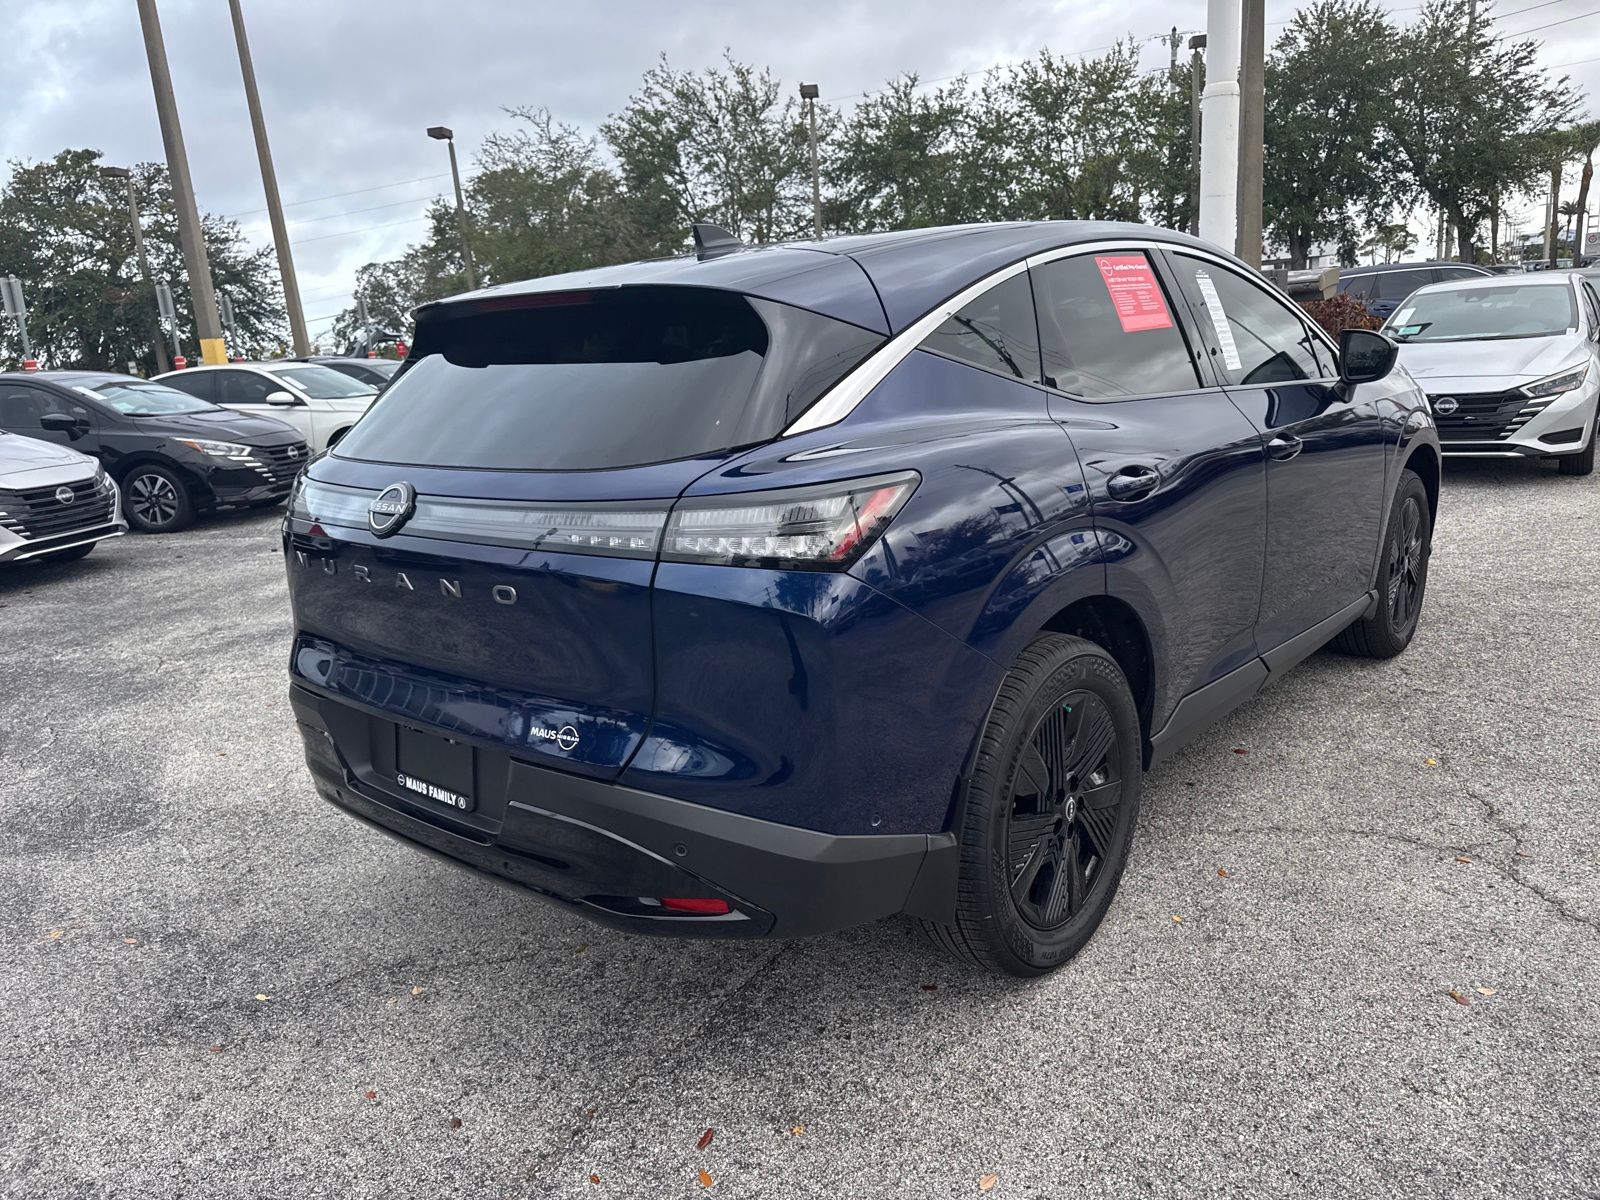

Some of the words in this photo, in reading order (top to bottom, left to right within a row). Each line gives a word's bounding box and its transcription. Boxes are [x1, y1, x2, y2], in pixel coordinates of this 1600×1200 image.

[296, 551, 518, 605] MURANO
[530, 726, 556, 740] MAUS
[405, 776, 427, 795] MAUS
[428, 785, 457, 806] FAMILY
